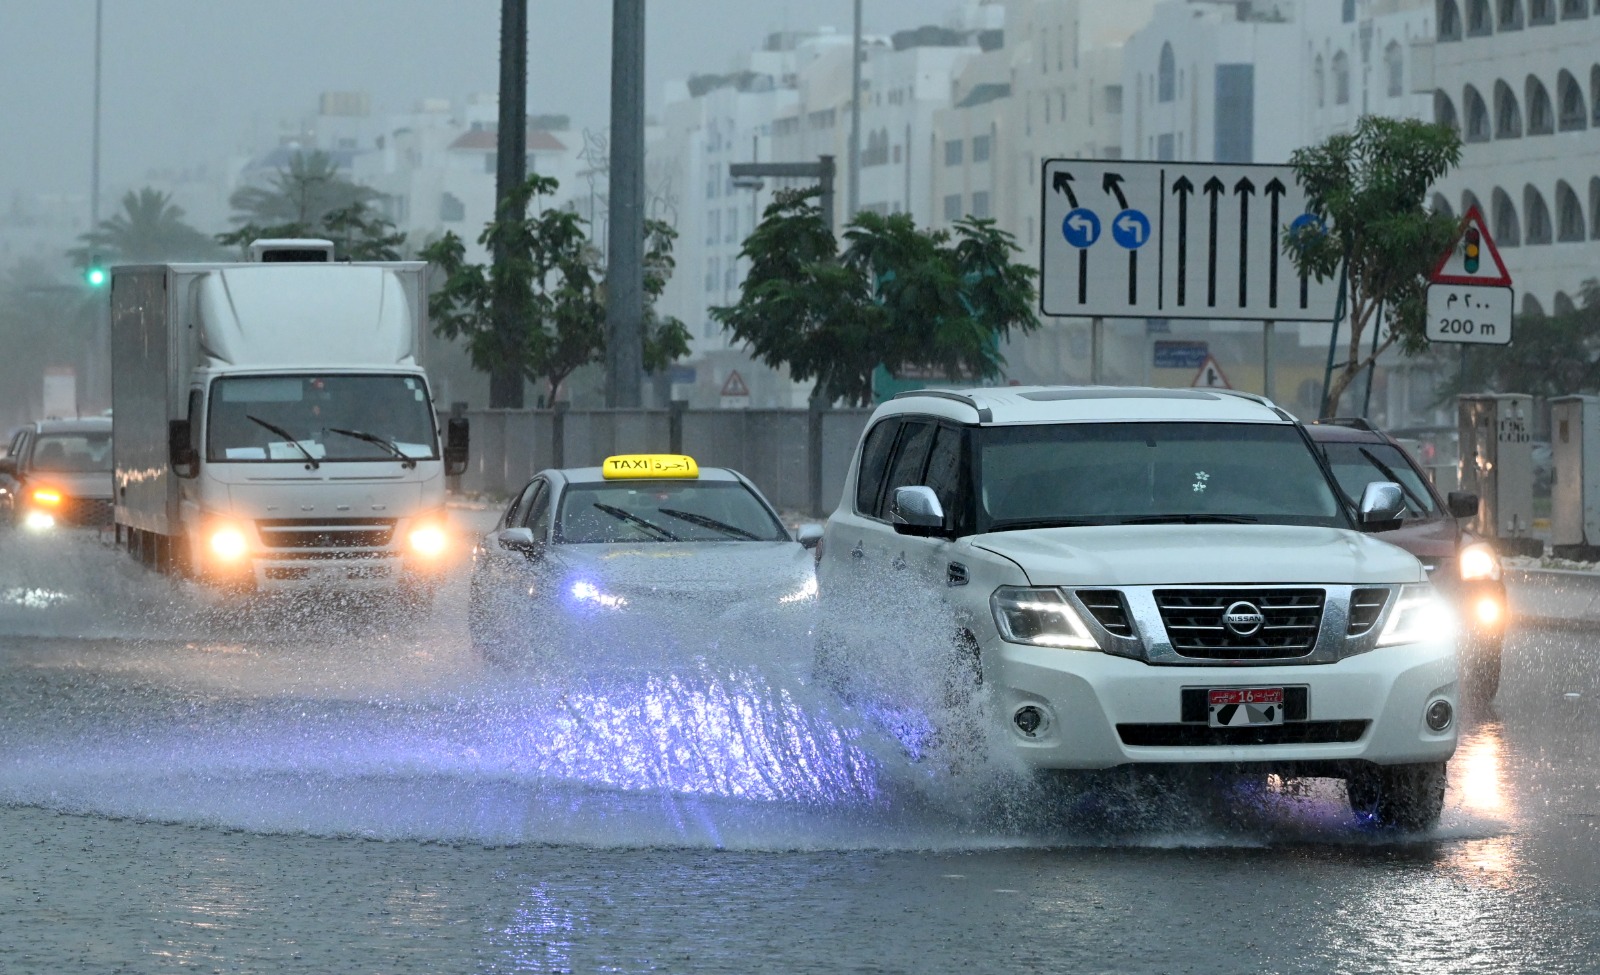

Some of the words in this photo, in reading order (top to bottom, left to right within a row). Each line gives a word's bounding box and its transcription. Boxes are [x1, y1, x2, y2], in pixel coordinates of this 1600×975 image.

[1447, 293, 1458, 311] م
[1464, 293, 1490, 309] ٢٠٠
[1440, 318, 1474, 335] 200
[1480, 323, 1496, 336] m
[610, 460, 648, 470] TAXI
[655, 457, 690, 472] أجرة
[1238, 691, 1254, 703] 16
